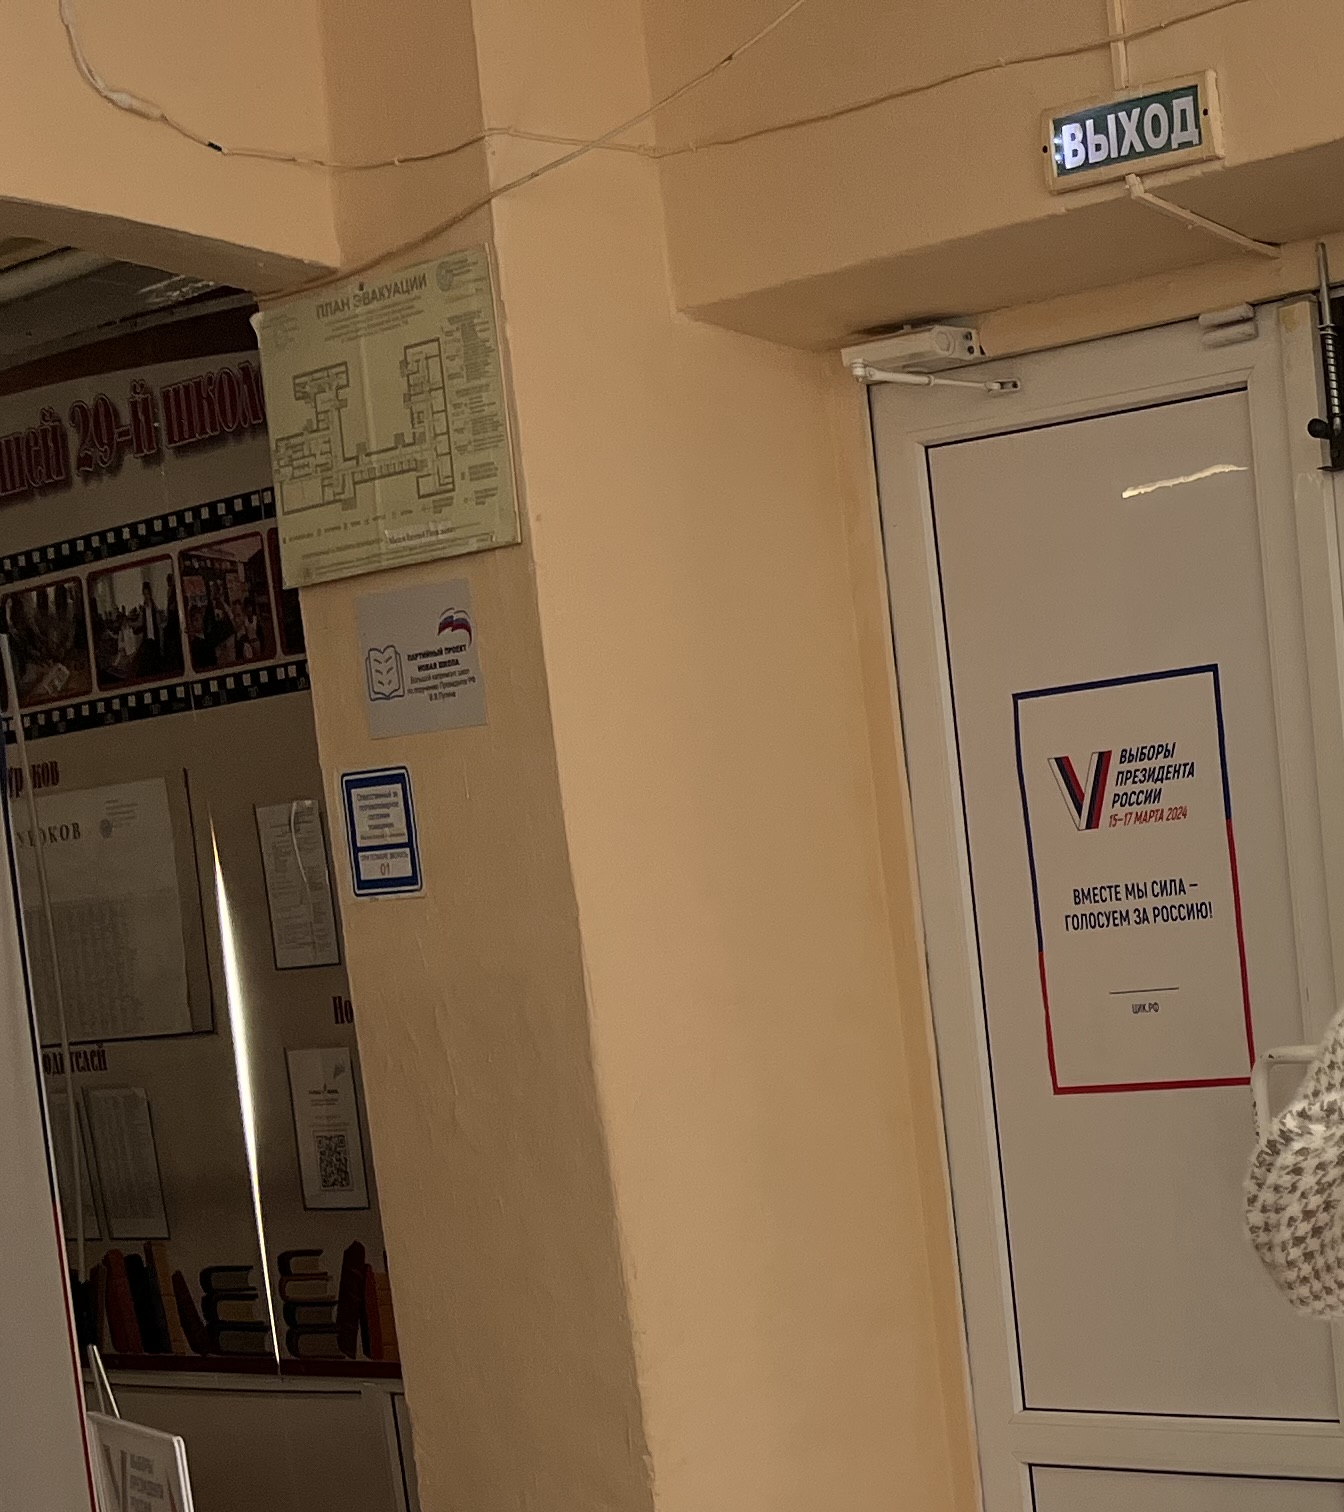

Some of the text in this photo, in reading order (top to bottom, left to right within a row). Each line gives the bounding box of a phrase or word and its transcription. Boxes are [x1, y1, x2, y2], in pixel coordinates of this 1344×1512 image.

[1061, 96, 1199, 169] ВЫХОД
[316, 273, 428, 319] ПЛАН ЭВАКУАЦИИ
[1119, 742, 1177, 765] ВЫБОРЫ
[1115, 761, 1195, 787] ПРЕЗИДЕНТА
[1111, 787, 1163, 809] РОССИИ
[1133, 808, 1165, 825] МАРТА
[1165, 805, 1188, 822] 2024
[380, 862, 390, 876] 01
[1073, 884, 1122, 906] ВМЕСТЕ
[1124, 881, 1148, 901] МЫ
[1151, 878, 1187, 898] СИЛА
[1065, 901, 1214, 931] ГОЛОСУЕМ ЗА РОССИЮ!
